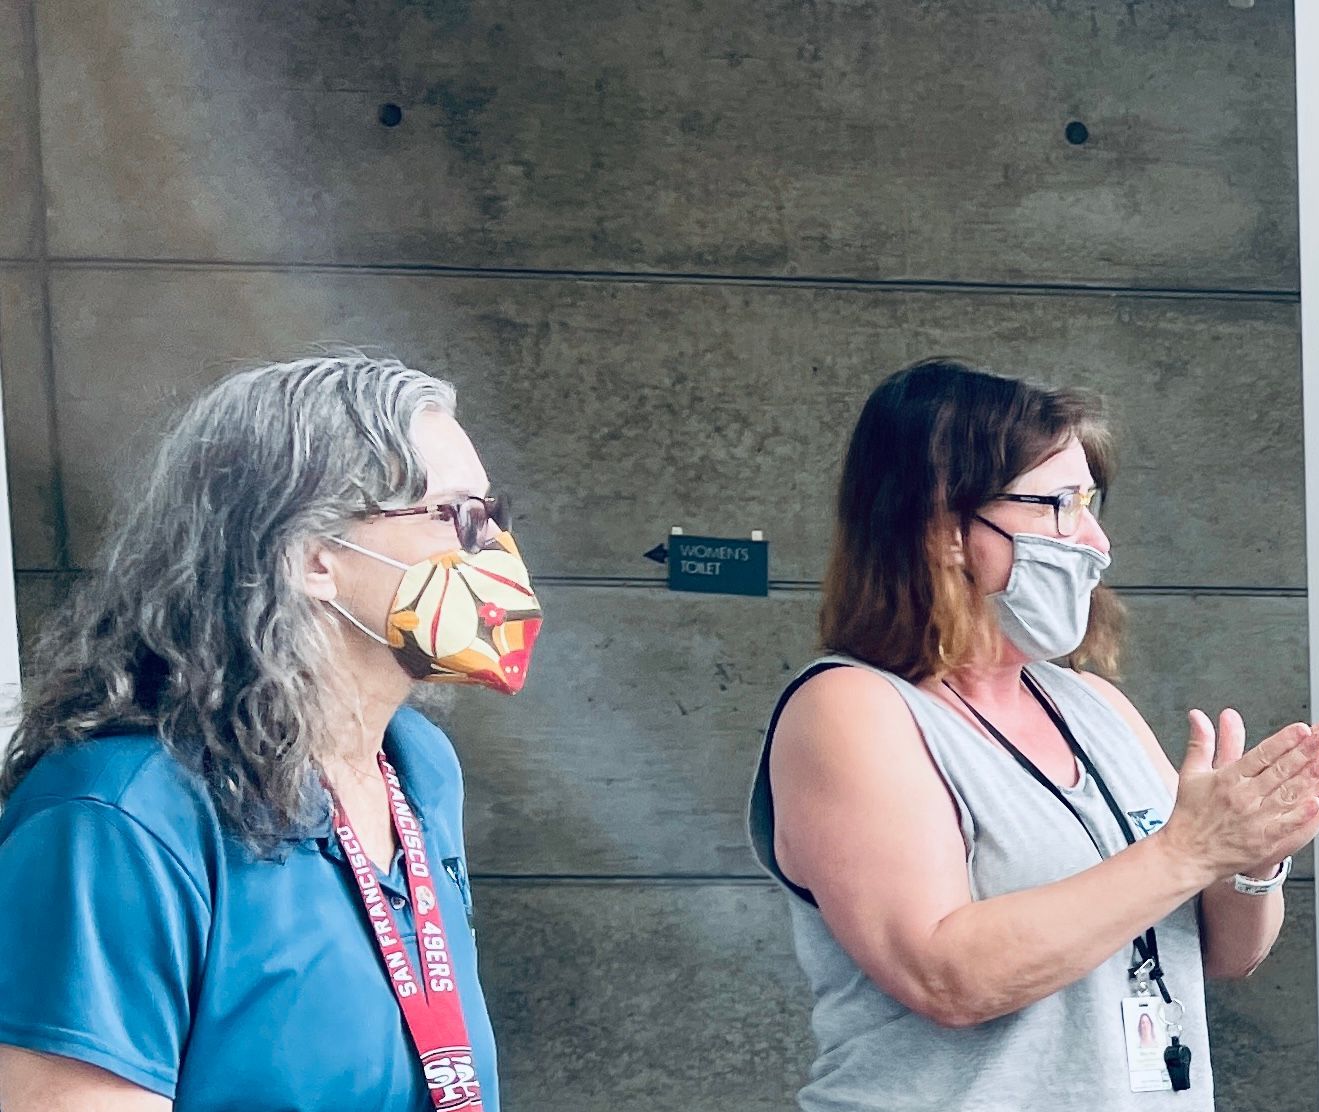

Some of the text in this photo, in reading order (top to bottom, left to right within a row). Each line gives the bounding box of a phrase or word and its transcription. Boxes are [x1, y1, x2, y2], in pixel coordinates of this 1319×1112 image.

[680, 560, 721, 576] TOILET
[336, 824, 418, 998] SAN FRANCISCO
[382, 760, 454, 993] FRANCISCO 49ERS
